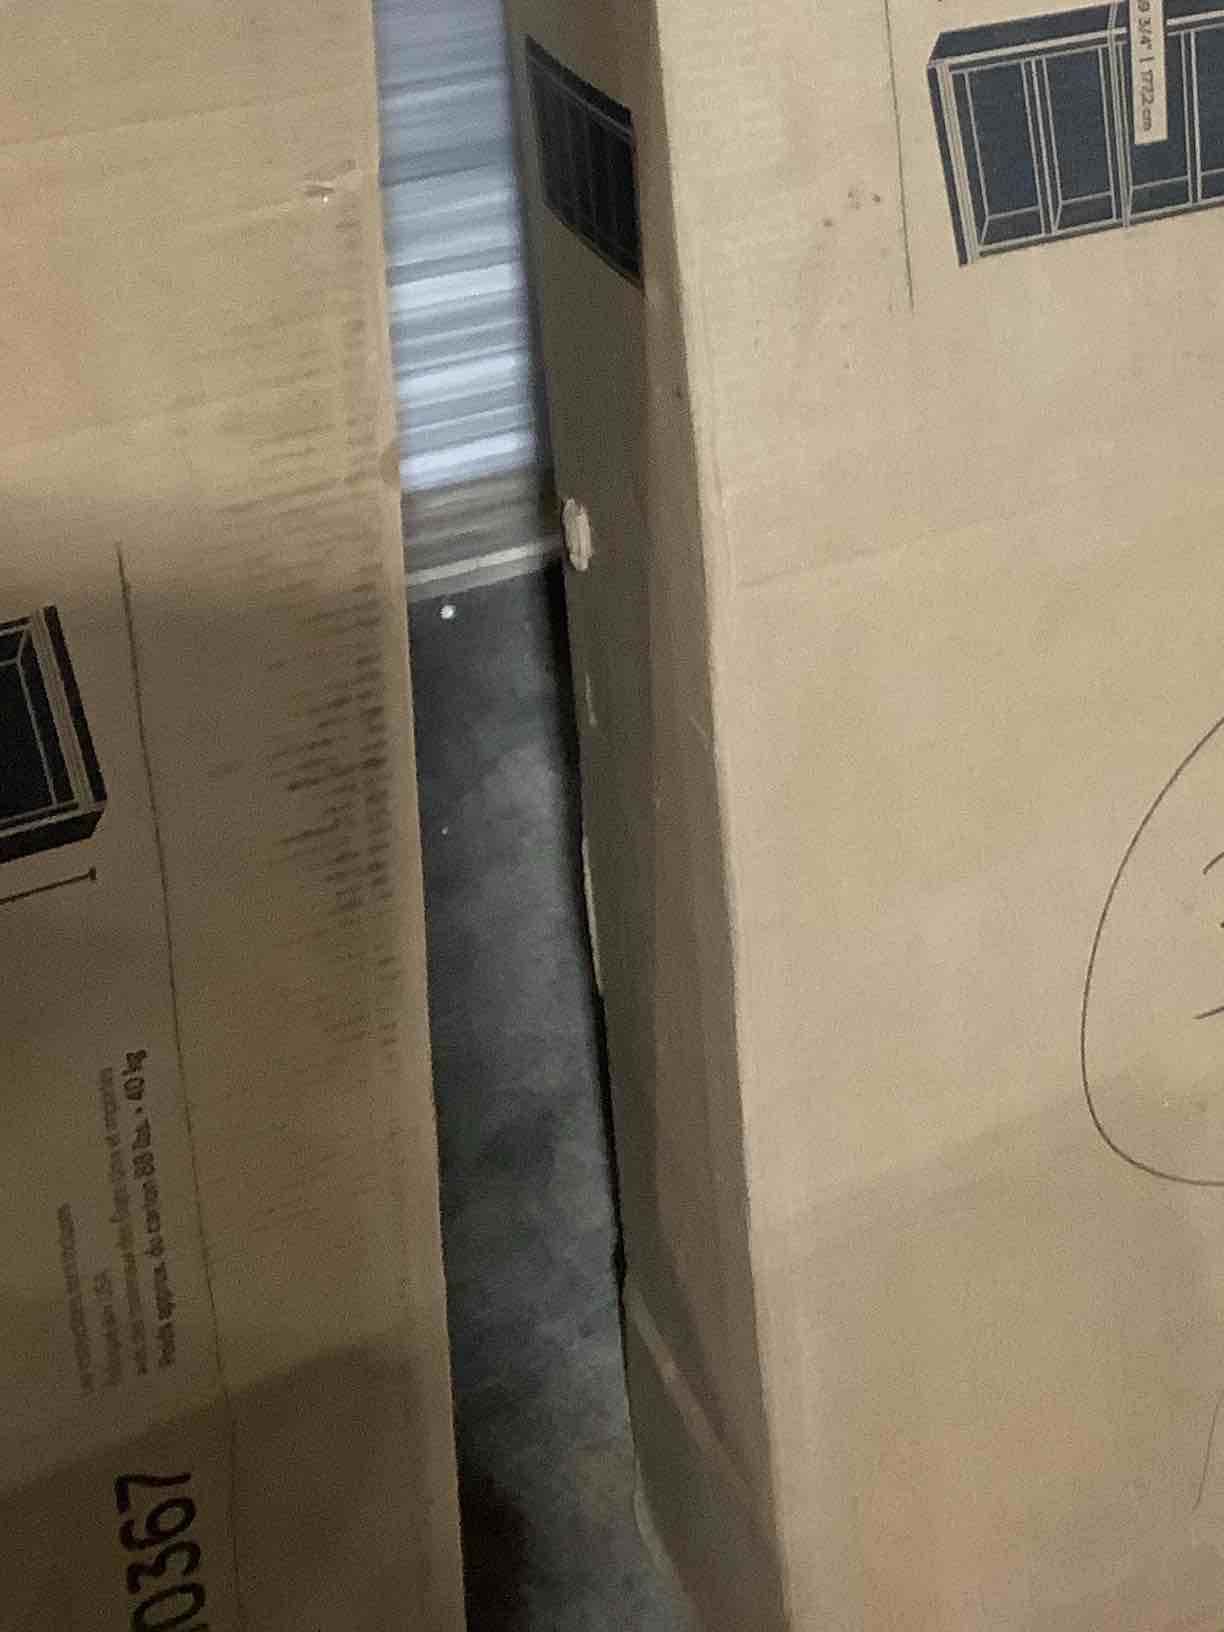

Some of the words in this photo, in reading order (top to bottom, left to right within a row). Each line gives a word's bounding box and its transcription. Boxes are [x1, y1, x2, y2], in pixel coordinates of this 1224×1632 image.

[121, 1048, 148, 1073] kg
[123, 1076, 146, 1100] 40
[113, 1471, 208, 1631] 0367
